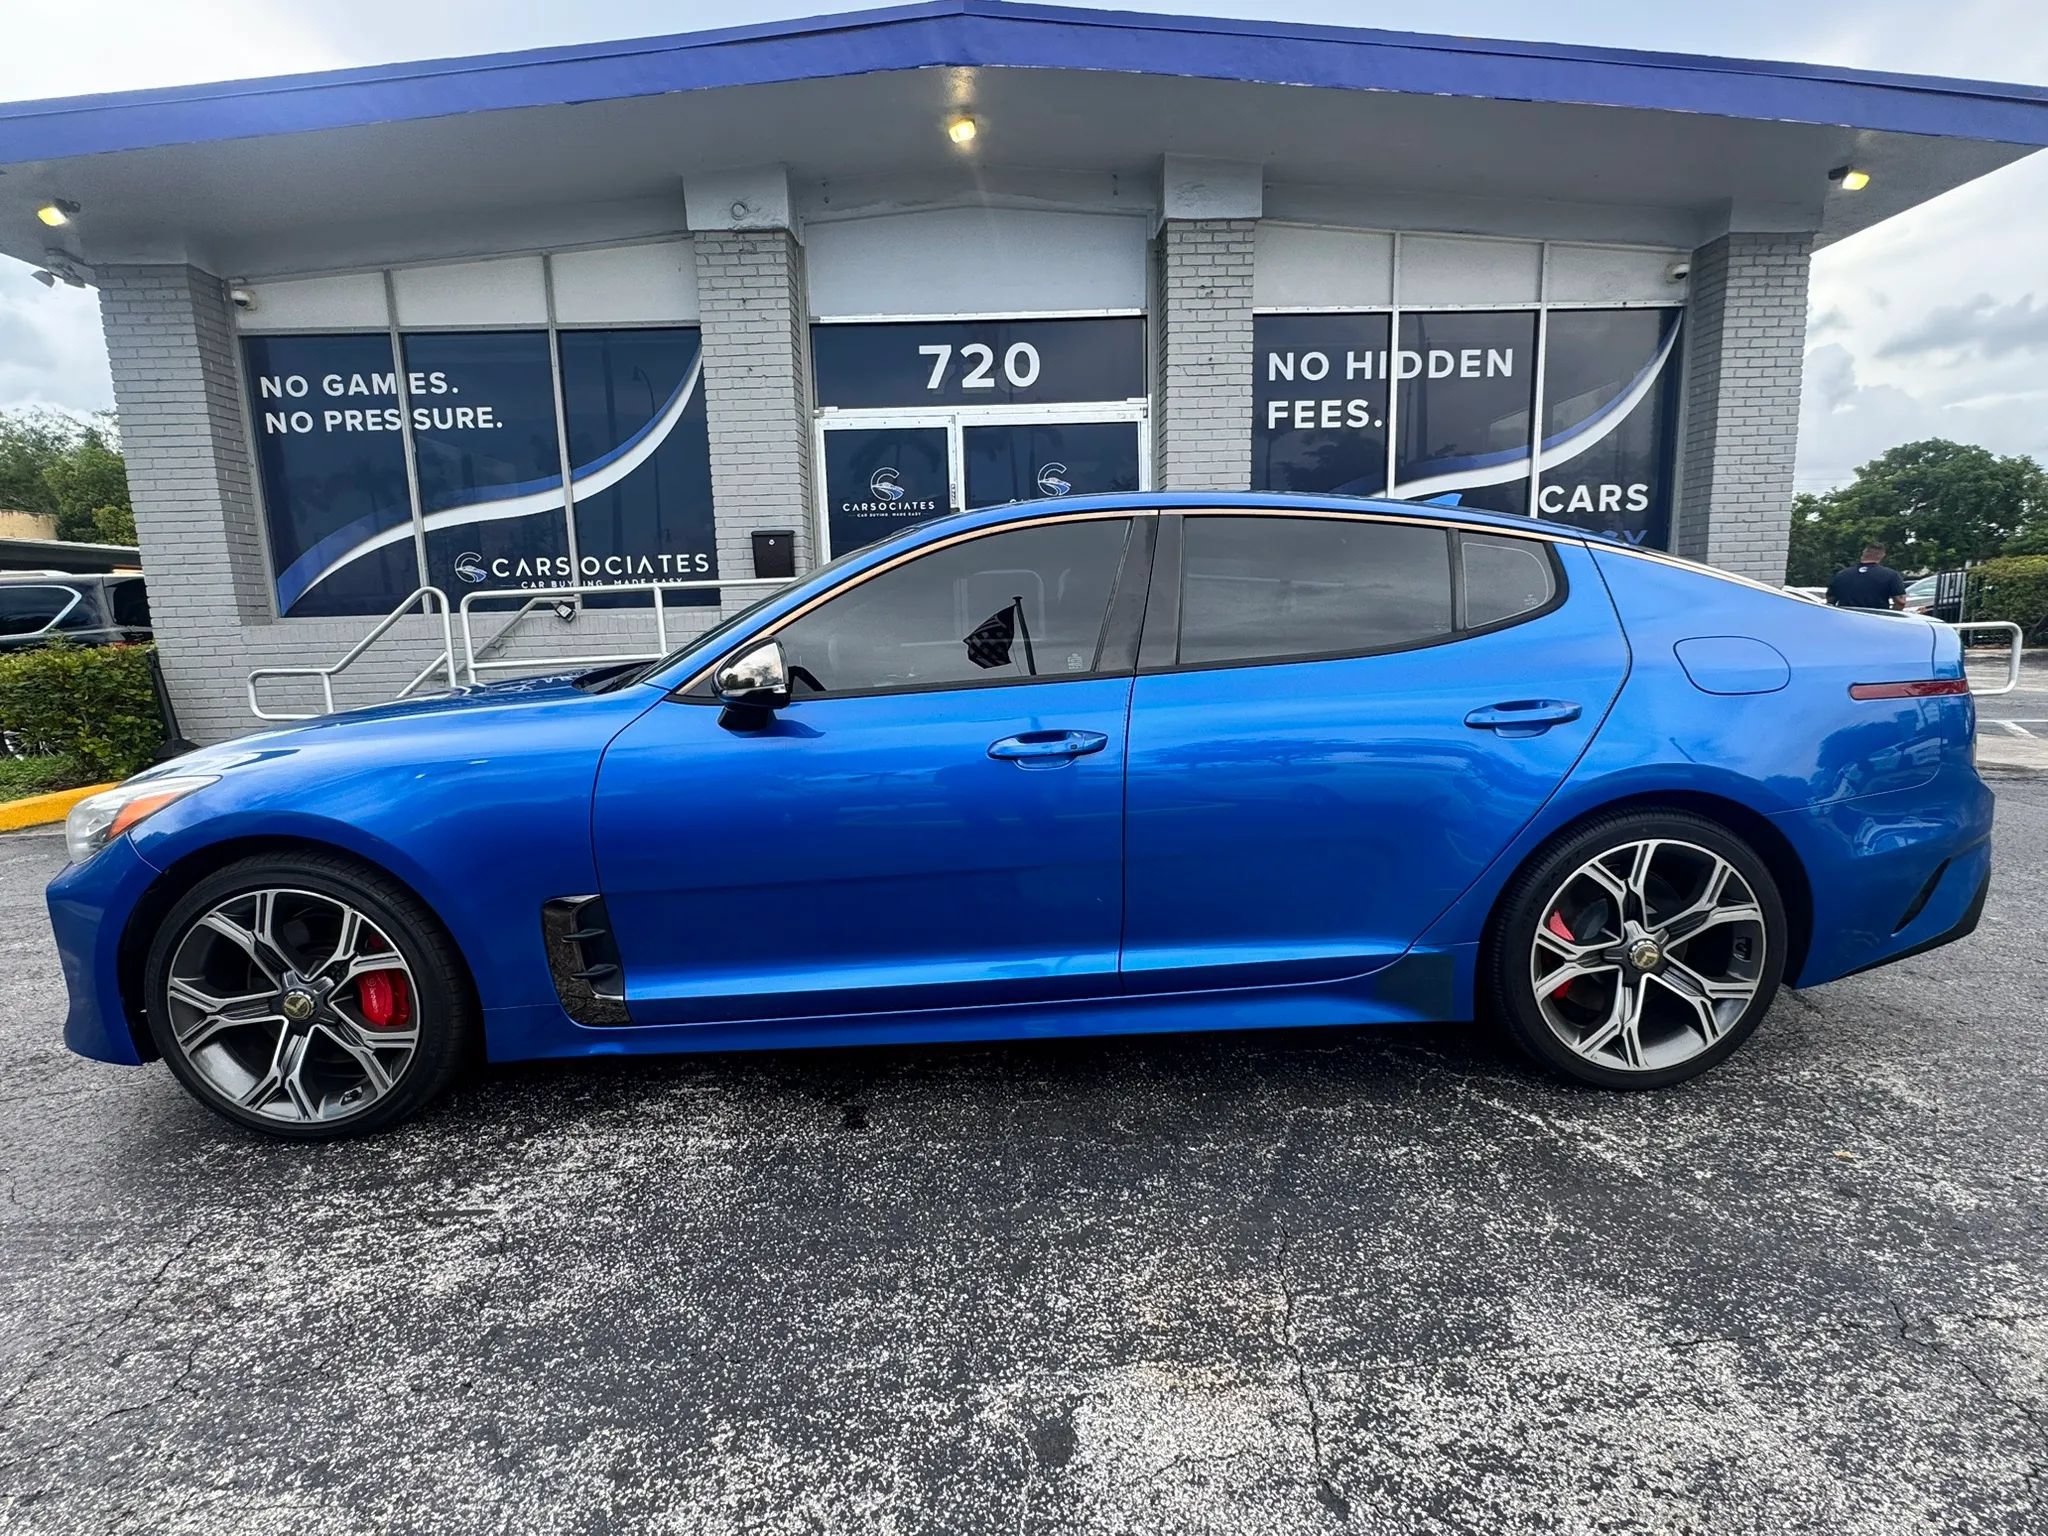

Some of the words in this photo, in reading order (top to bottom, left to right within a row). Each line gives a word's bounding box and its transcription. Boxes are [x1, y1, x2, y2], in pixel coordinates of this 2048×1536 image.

[918, 341, 1041, 390] 720
[1267, 351, 1330, 381] NO
[1346, 348, 1515, 380] HIDDEN
[260, 374, 310, 399] NO
[322, 371, 459, 397] GAMES.
[266, 411, 314, 434] NO
[325, 406, 504, 433] PRESSURE.
[1267, 399, 1383, 430] FEES.
[842, 501, 936, 512] CARSOCIATES
[1538, 483, 1649, 514] CARS
[491, 553, 710, 578] CARSOCIATES
[520, 580, 545, 589] CAR
